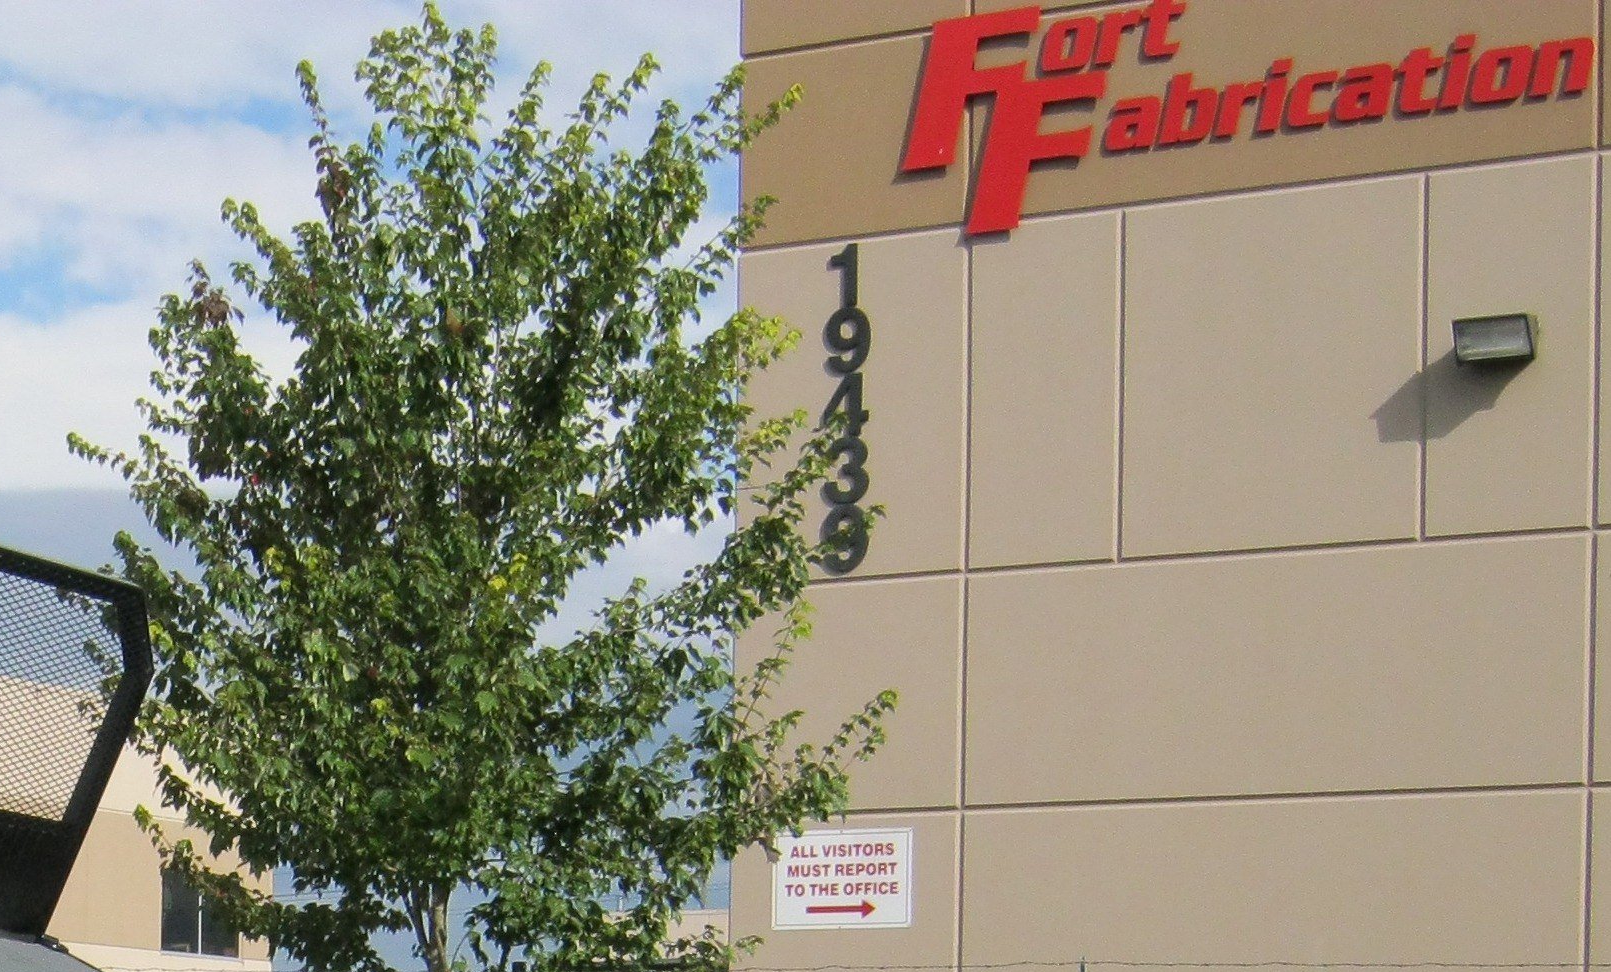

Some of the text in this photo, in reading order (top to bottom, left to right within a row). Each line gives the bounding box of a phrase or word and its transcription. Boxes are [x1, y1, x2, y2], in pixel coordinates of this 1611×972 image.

[902, 0, 1187, 172] Fort
[967, 34, 1595, 235] Fabrication
[820, 243, 871, 575] 19439
[785, 881, 900, 897] TO THE OFFICE
[786, 862, 898, 878] MUST REPORT
[790, 843, 895, 859] ALL VISITORS
